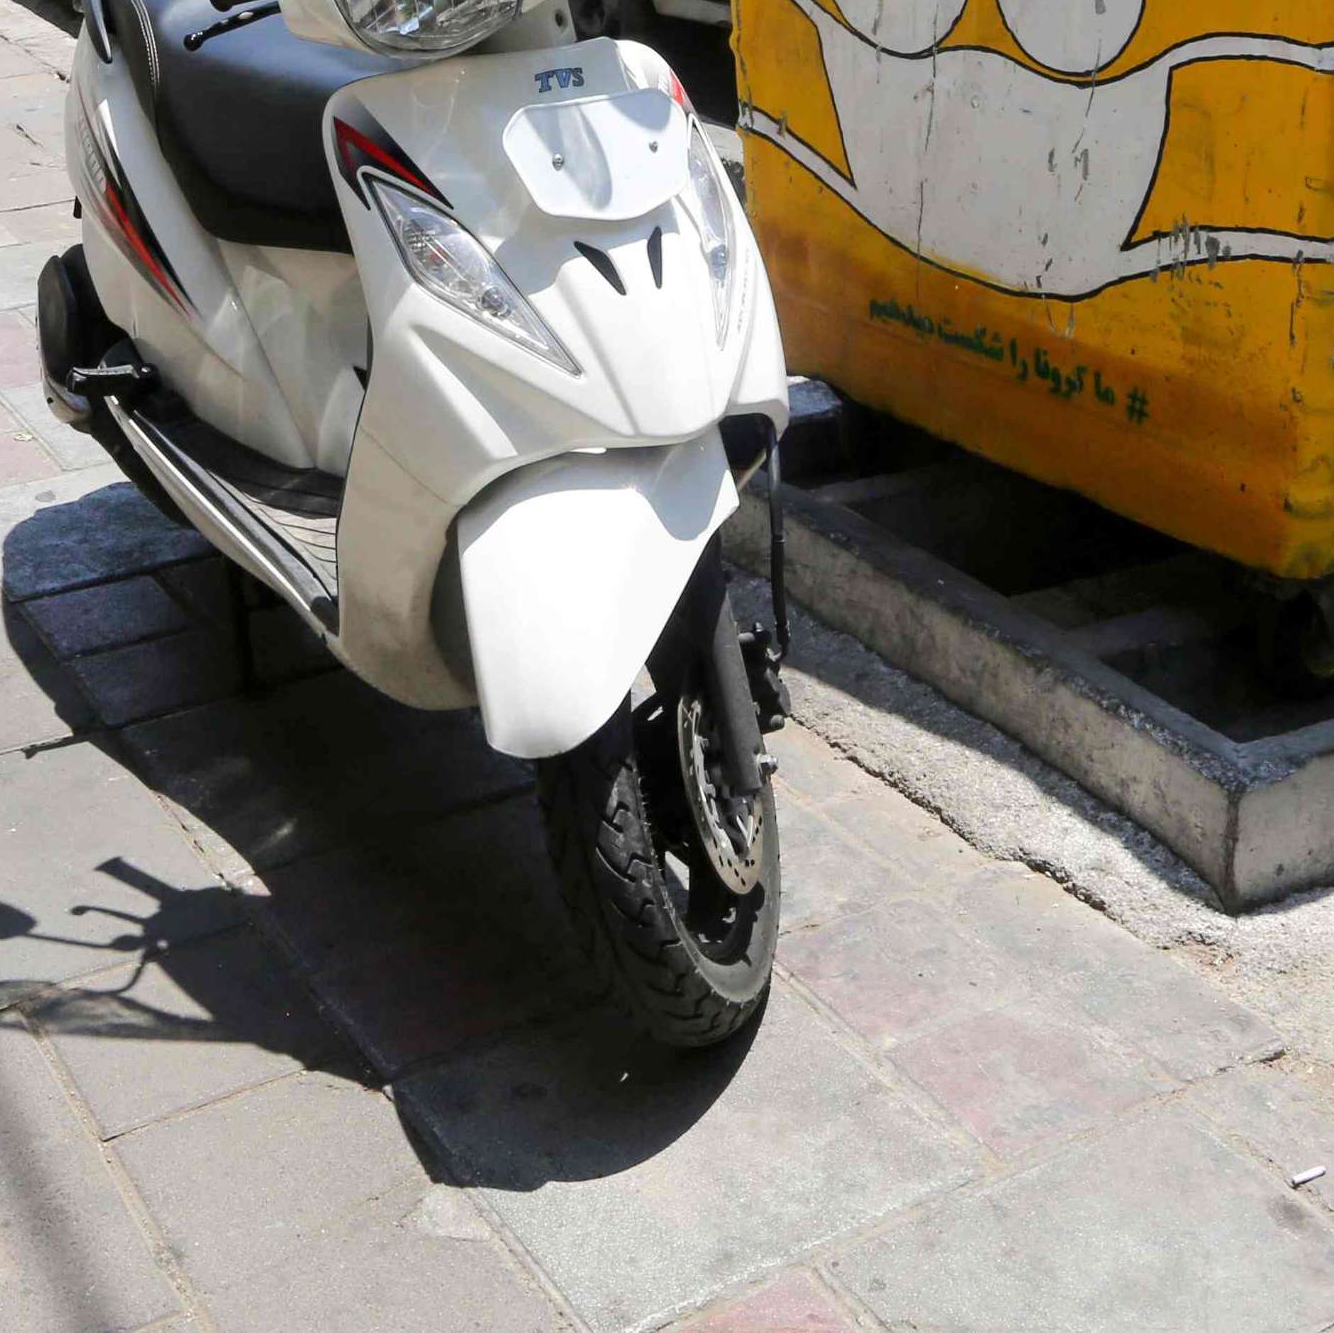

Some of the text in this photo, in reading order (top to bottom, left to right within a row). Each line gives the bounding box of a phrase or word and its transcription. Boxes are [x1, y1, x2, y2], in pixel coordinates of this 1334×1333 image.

[535, 67, 584, 93] TVS
[937, 317, 1005, 362] شکست
[1008, 336, 1029, 382] را
[1034, 347, 1087, 398] کرونا
[1093, 371, 1116, 405] ما
